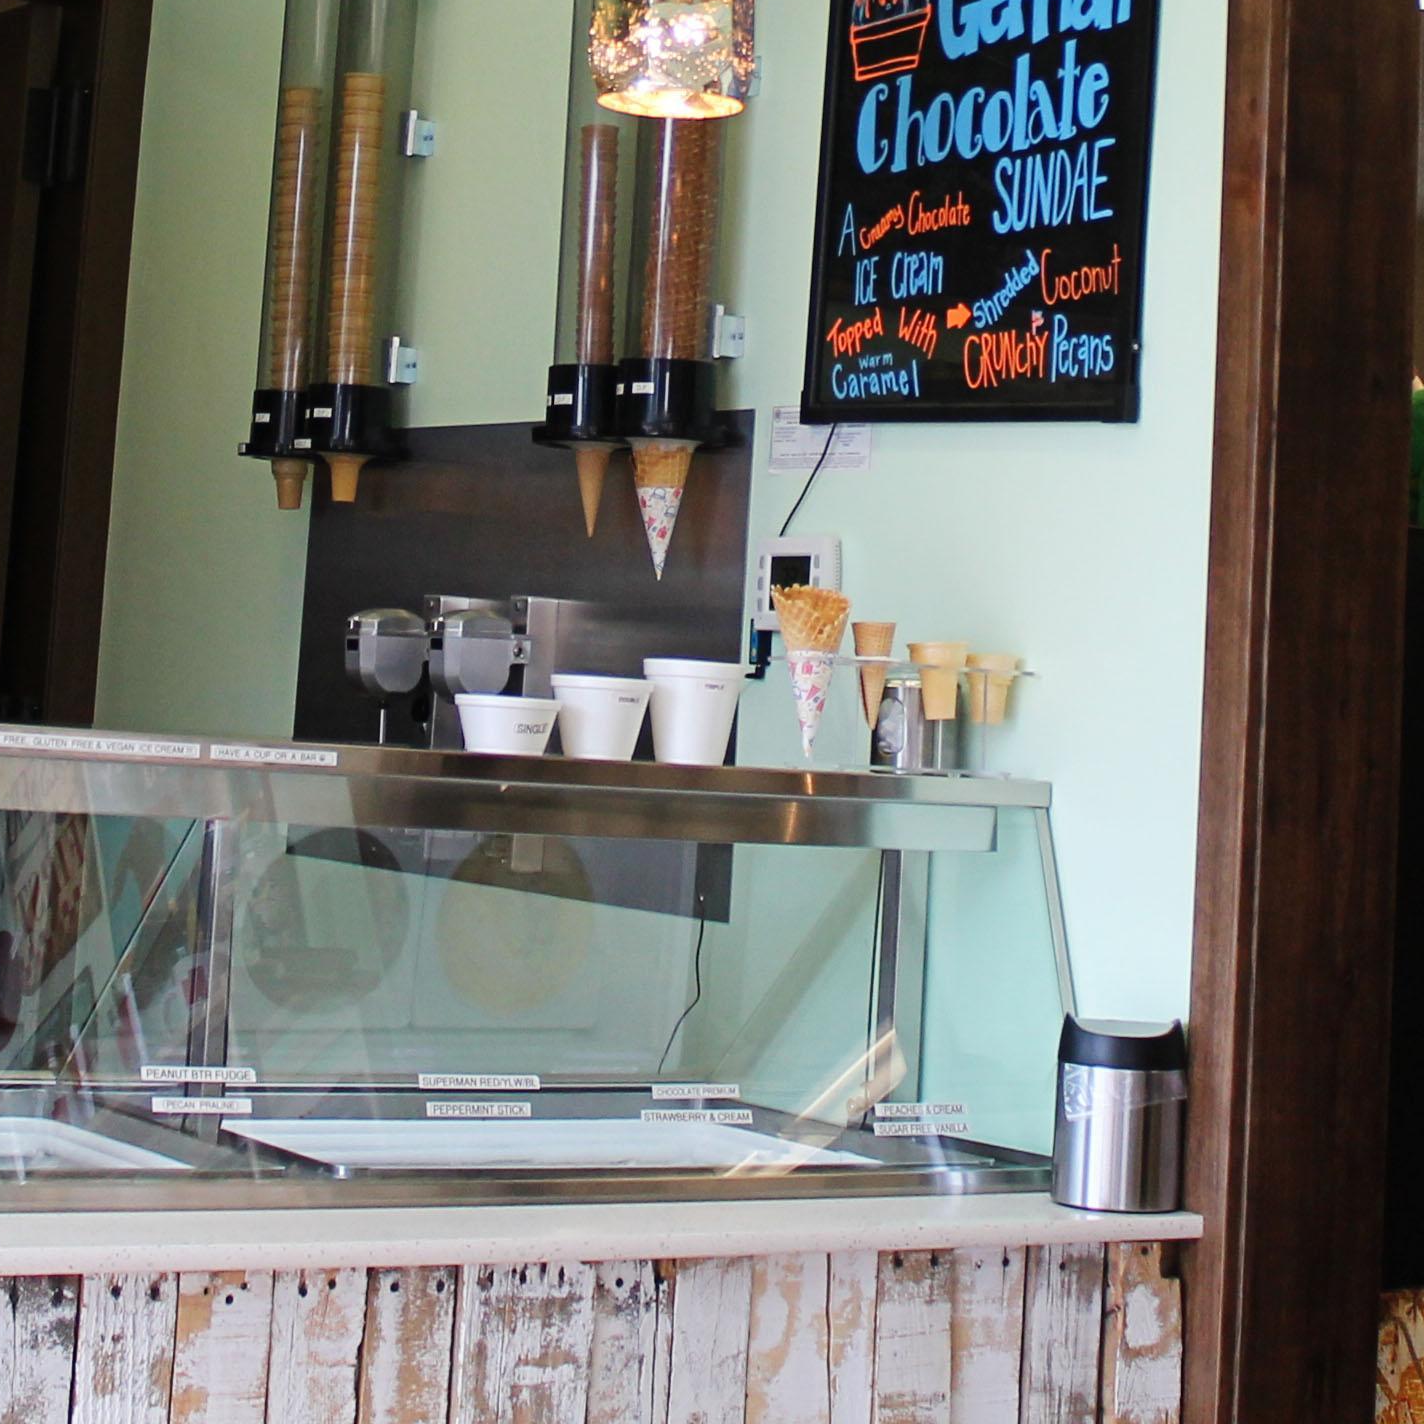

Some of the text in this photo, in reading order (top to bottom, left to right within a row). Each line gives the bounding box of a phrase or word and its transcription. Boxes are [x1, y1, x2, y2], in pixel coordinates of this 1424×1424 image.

[856, 39, 1111, 175] Chocolate
[992, 137, 1116, 235] SUNDAE
[838, 189, 971, 257] A Chocolate
[854, 255, 880, 307] ICE
[1041, 243, 1122, 306] Coconut
[826, 306, 939, 361] Topped With
[1051, 314, 1114, 384] Pecans
[832, 359, 920, 400] Caramel
[32, 737, 67, 748] GLUTEN
[106, 742, 135, 752] VEGAN
[218, 750, 240, 758] HAVE
[146, 1068, 251, 1081] PEANUT BTR FUDGE
[422, 1076, 477, 1087] SUPERMAN
[655, 1087, 701, 1096] CHOCOLATE
[433, 1104, 525, 1116] PEPPERMINT STICK
[644, 1112, 750, 1122] STRAWBERRY CREAM
[883, 1104, 963, 1115] PEACHES CREAM
[878, 1123, 969, 1134] SUGAR FREE VANILLA
